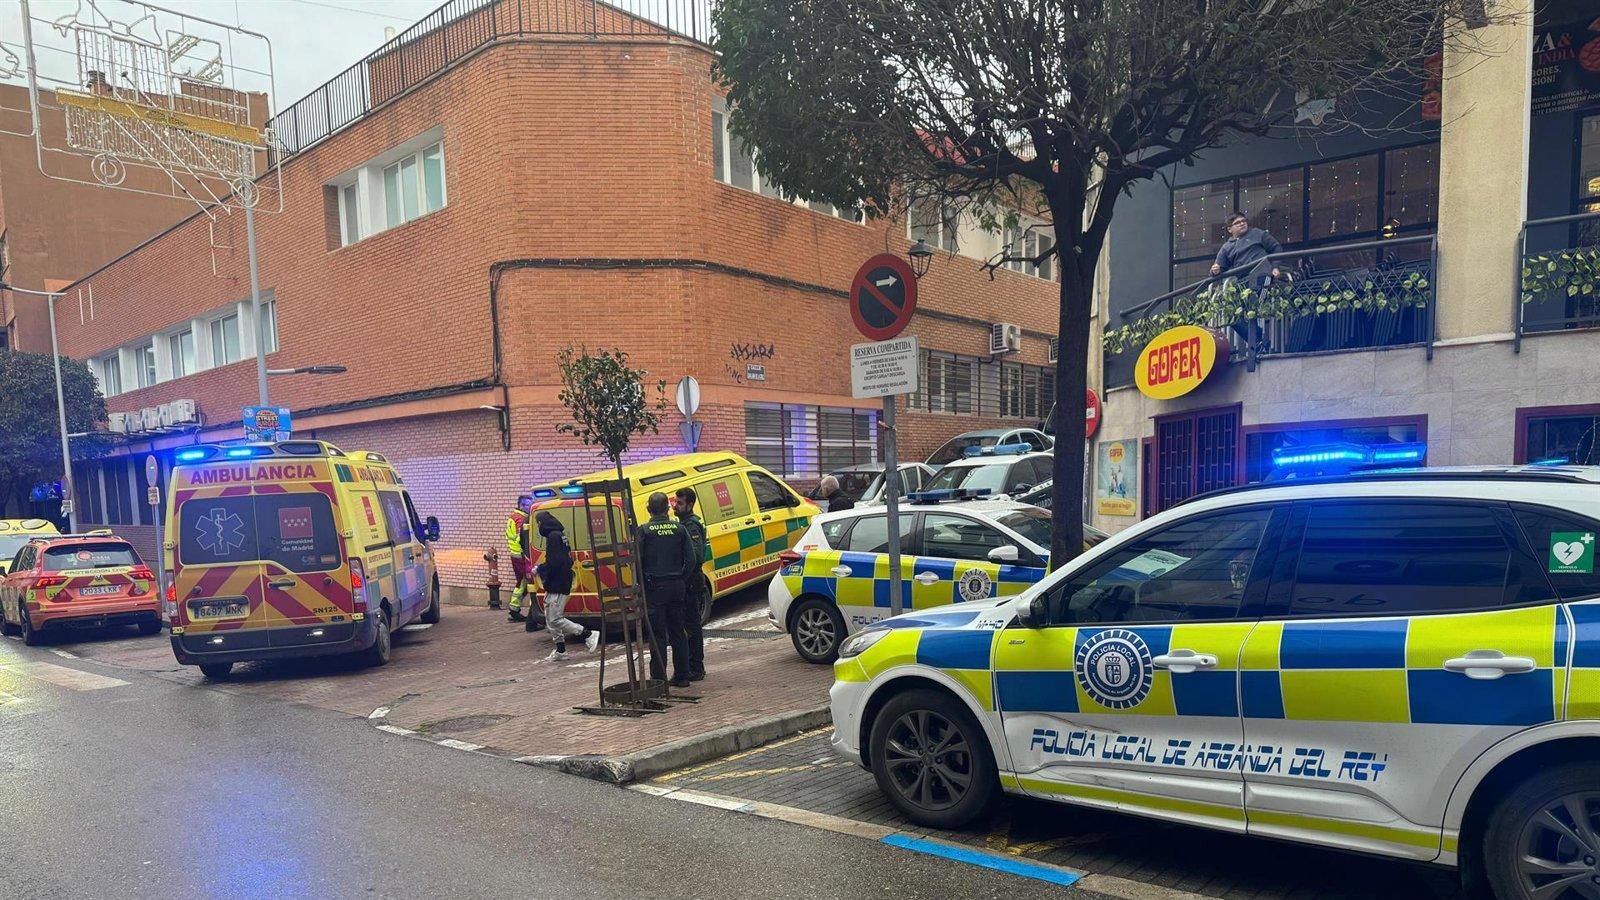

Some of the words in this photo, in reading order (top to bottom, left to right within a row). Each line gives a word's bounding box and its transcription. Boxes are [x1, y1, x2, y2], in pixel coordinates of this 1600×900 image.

[855, 346, 876, 357] RESERVA
[877, 341, 911, 353] COMPARTIDA
[1147, 336, 1202, 386] GOFER
[191, 464, 316, 485] AMBULANCIA
[201, 606, 222, 617] 8497
[226, 605, 243, 615] MNK
[313, 606, 338, 614] SN125
[1090, 643, 1115, 665] POLICÍA
[1117, 645, 1136, 667] LOCAL
[1031, 728, 1097, 757] POLICÍA
[1102, 735, 1156, 763] LOCAL
[1162, 739, 1191, 765] DE
[1192, 742, 1283, 773] ARGANDA
[1288, 748, 1332, 777] DEL
[1338, 751, 1388, 781] REY
